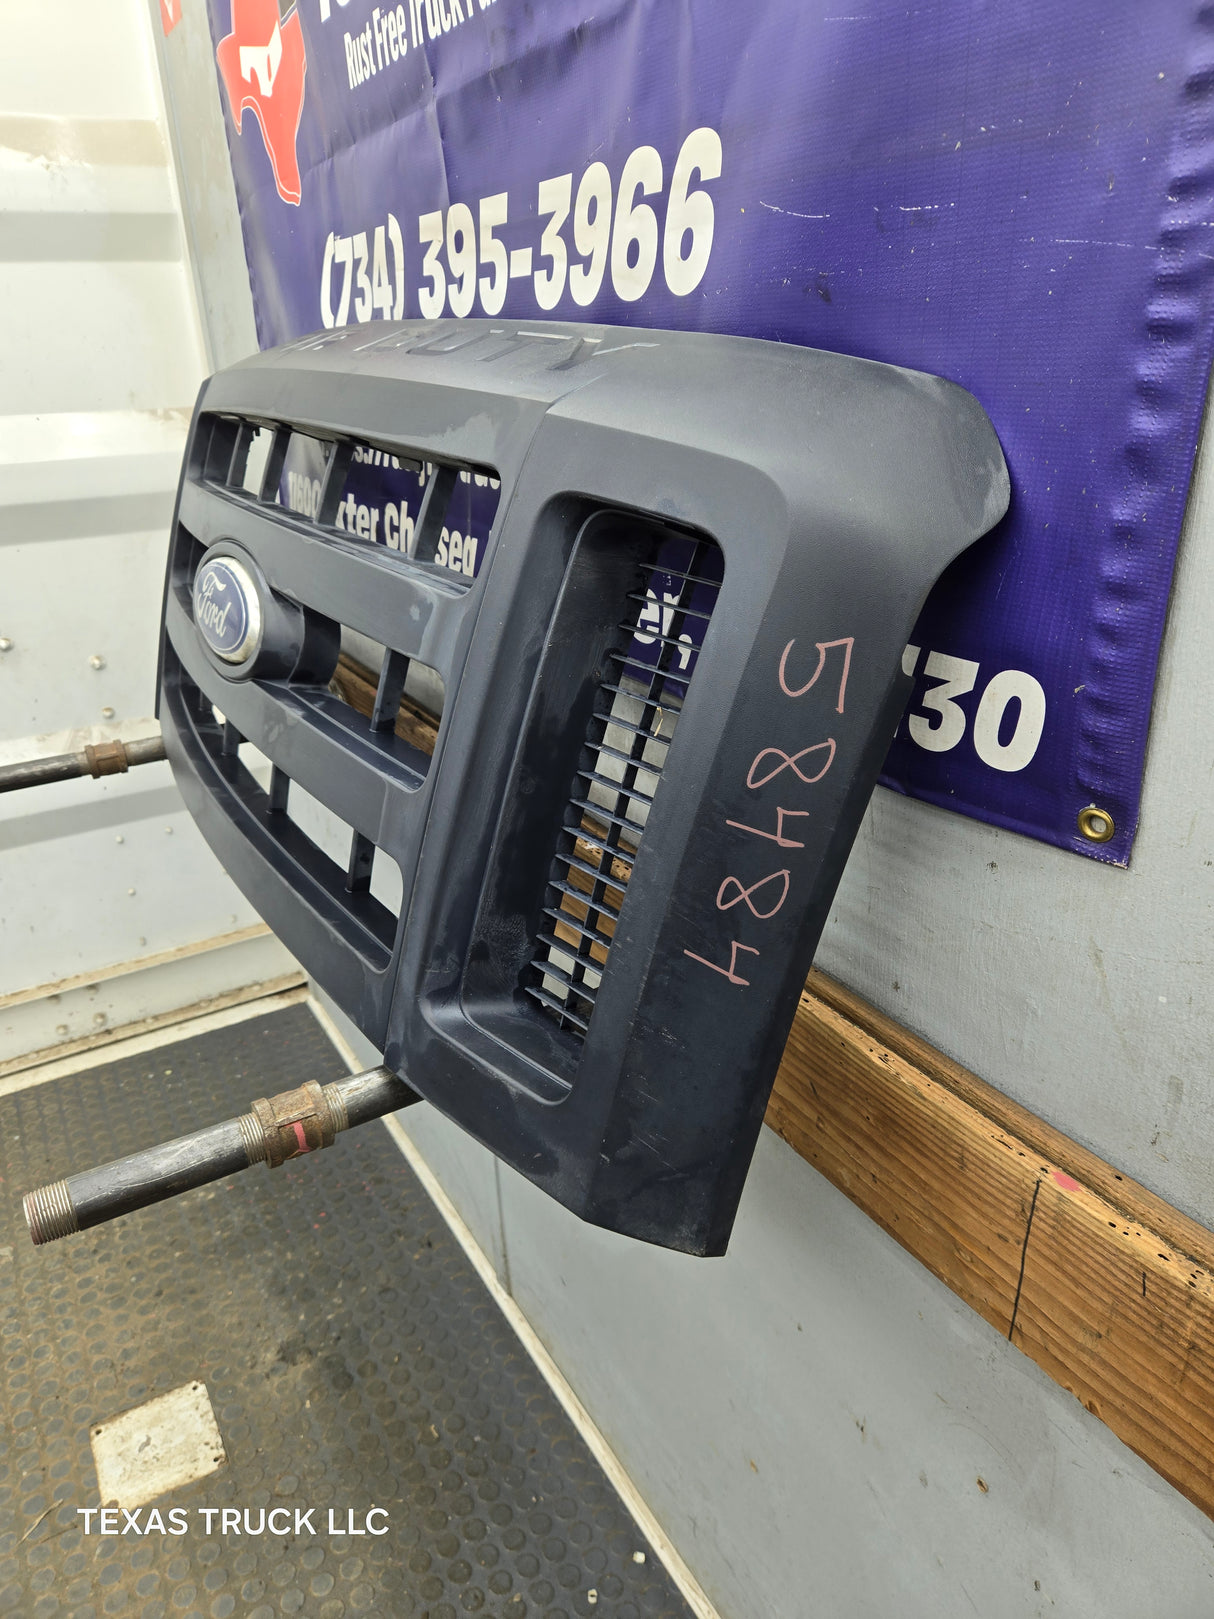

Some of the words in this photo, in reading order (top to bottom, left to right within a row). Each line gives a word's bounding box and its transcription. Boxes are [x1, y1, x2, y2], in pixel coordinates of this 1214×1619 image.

[343, 22, 377, 90] Rust
[372, 4, 408, 71] Free
[320, 213, 404, 329] (734)
[418, 127, 723, 320] 395-3966
[198, 571, 232, 638] Ford
